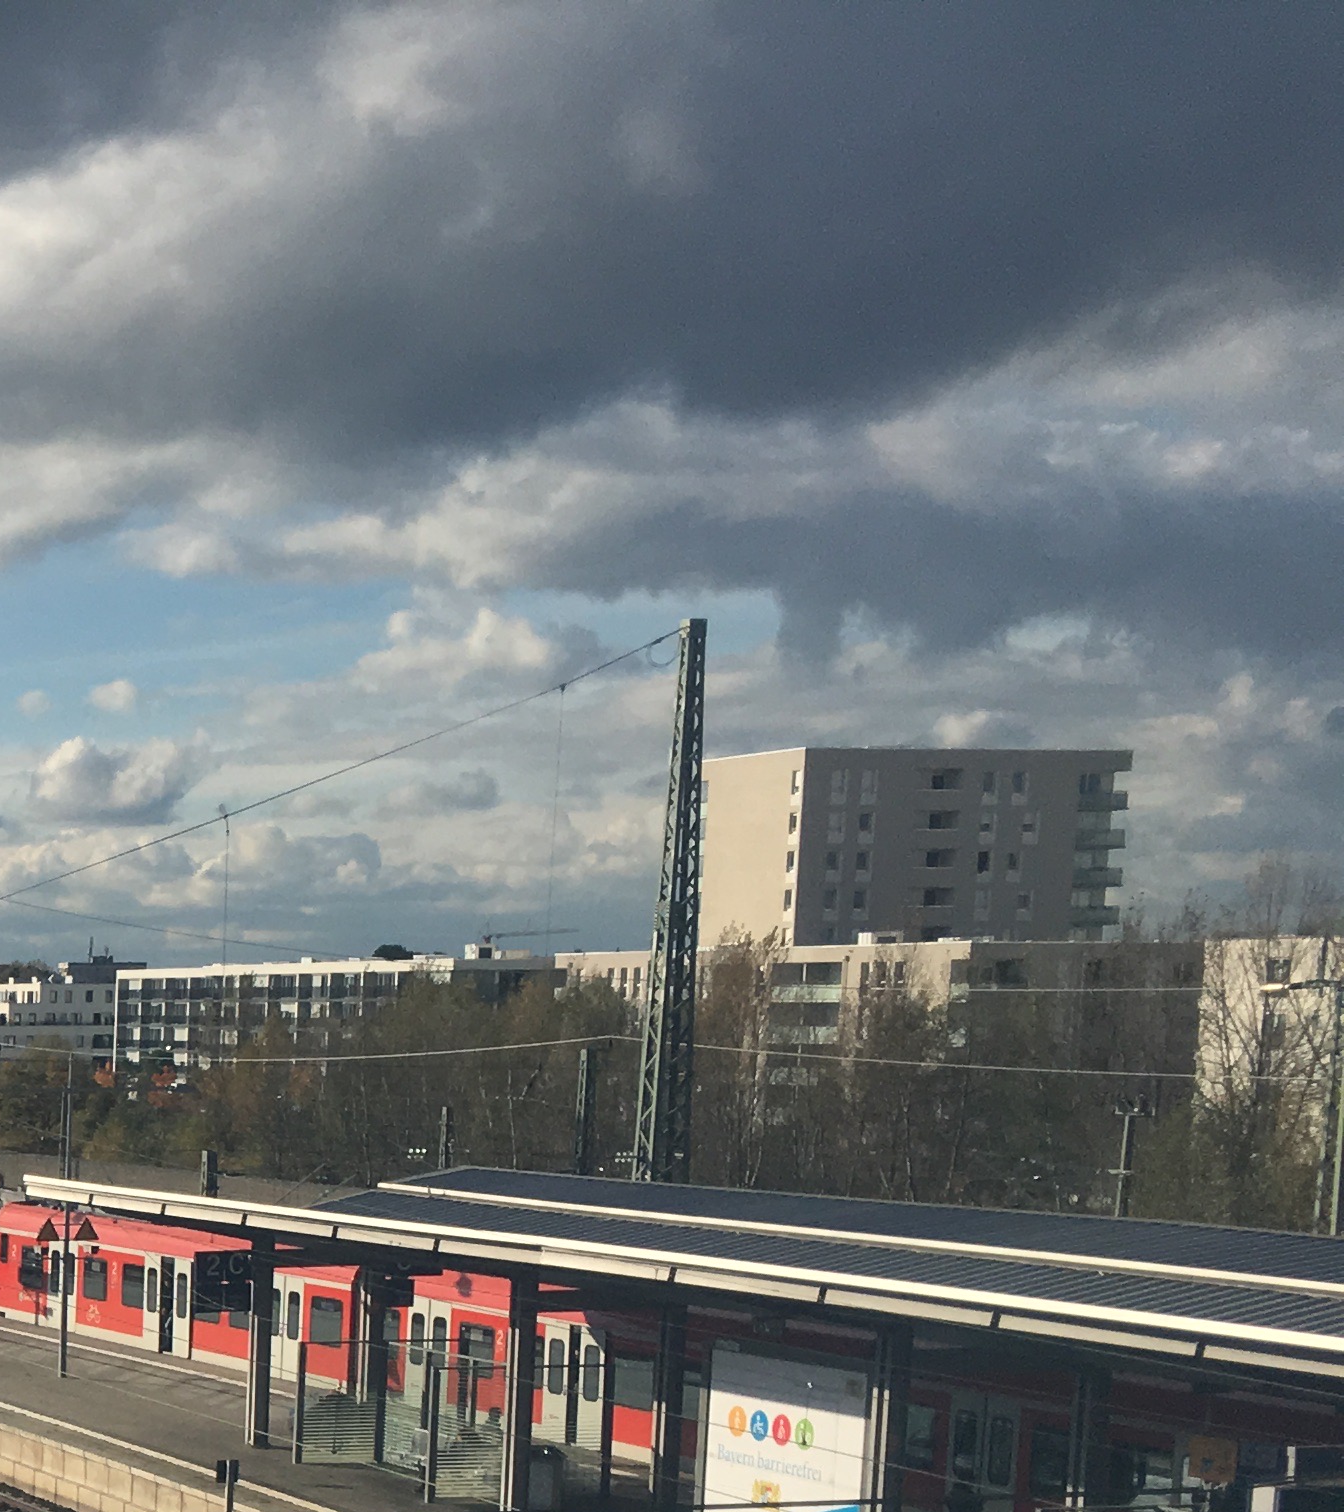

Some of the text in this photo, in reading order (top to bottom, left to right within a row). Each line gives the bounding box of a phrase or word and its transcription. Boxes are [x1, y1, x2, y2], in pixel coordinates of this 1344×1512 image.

[207, 1253, 244, 1276] 2 C
[496, 1329, 504, 1345] 2
[717, 1443, 823, 1481] Bayern barrierefrei
